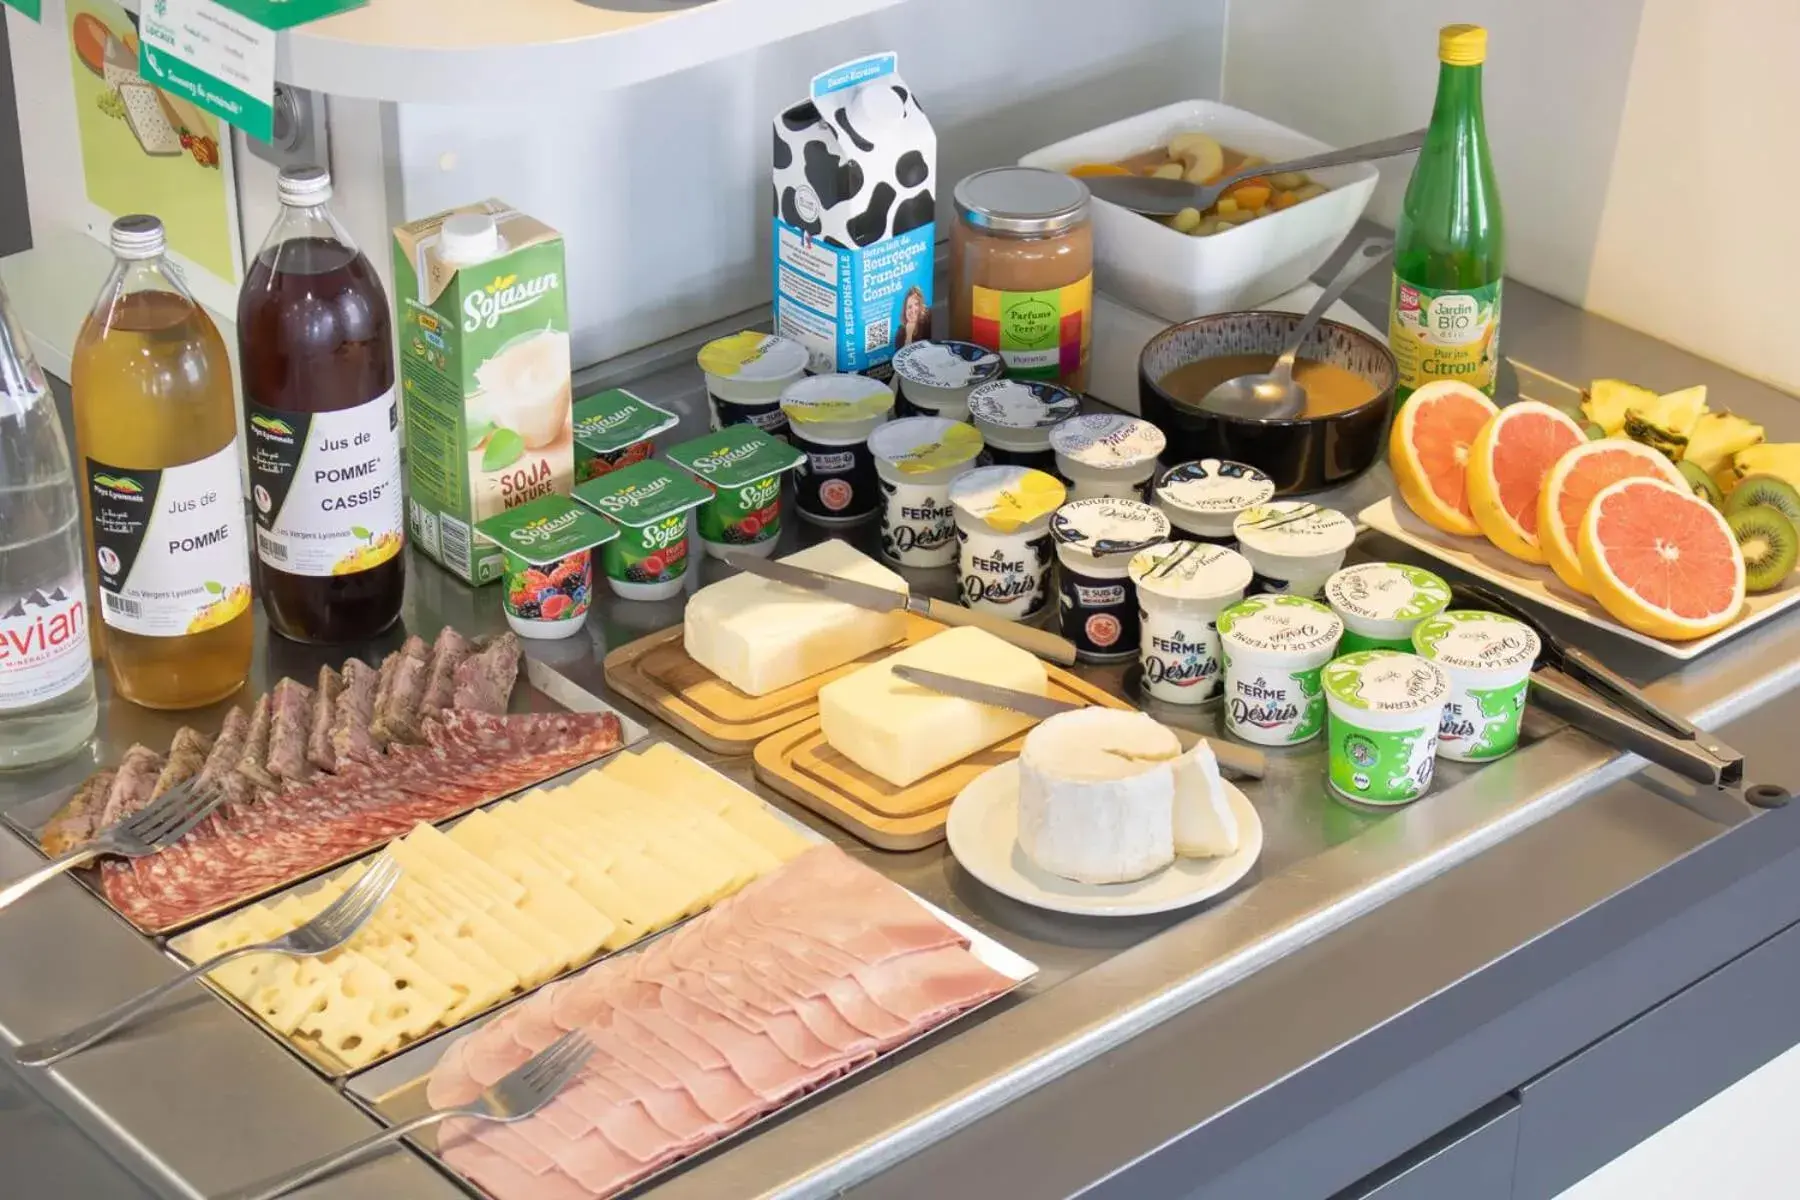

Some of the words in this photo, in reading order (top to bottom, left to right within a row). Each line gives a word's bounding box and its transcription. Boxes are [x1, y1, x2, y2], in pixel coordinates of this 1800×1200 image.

[862, 241, 927, 273] Bourgogne
[463, 271, 560, 333] Sojasun
[862, 279, 904, 303] Comté
[1010, 310, 1052, 321] Parfums
[1435, 303, 1473, 316] Jardin
[1421, 358, 1477, 376] Citron
[573, 404, 639, 439] Sojasun
[319, 436, 348, 452] Jus
[353, 431, 371, 447] de
[692, 438, 769, 474] Sojasun
[500, 458, 552, 496] SOJA
[109, 489, 144, 503] Lyonnais
[168, 498, 196, 515] Jus
[200, 491, 217, 507] de
[503, 479, 554, 509] NATURE
[600, 475, 673, 512] Sojasun
[510, 508, 585, 545] Sojasun
[901, 504, 953, 521] FERME
[168, 524, 229, 555] POMME
[893, 520, 958, 551] Désiri
[972, 555, 1025, 573] FERME
[965, 572, 1035, 603] Désiris
[0, 599, 85, 661] evian
[1152, 635, 1207, 655] FERME
[1145, 655, 1218, 685] Désiris
[1236, 680, 1287, 701] FERME
[1230, 697, 1299, 725] Désiris
